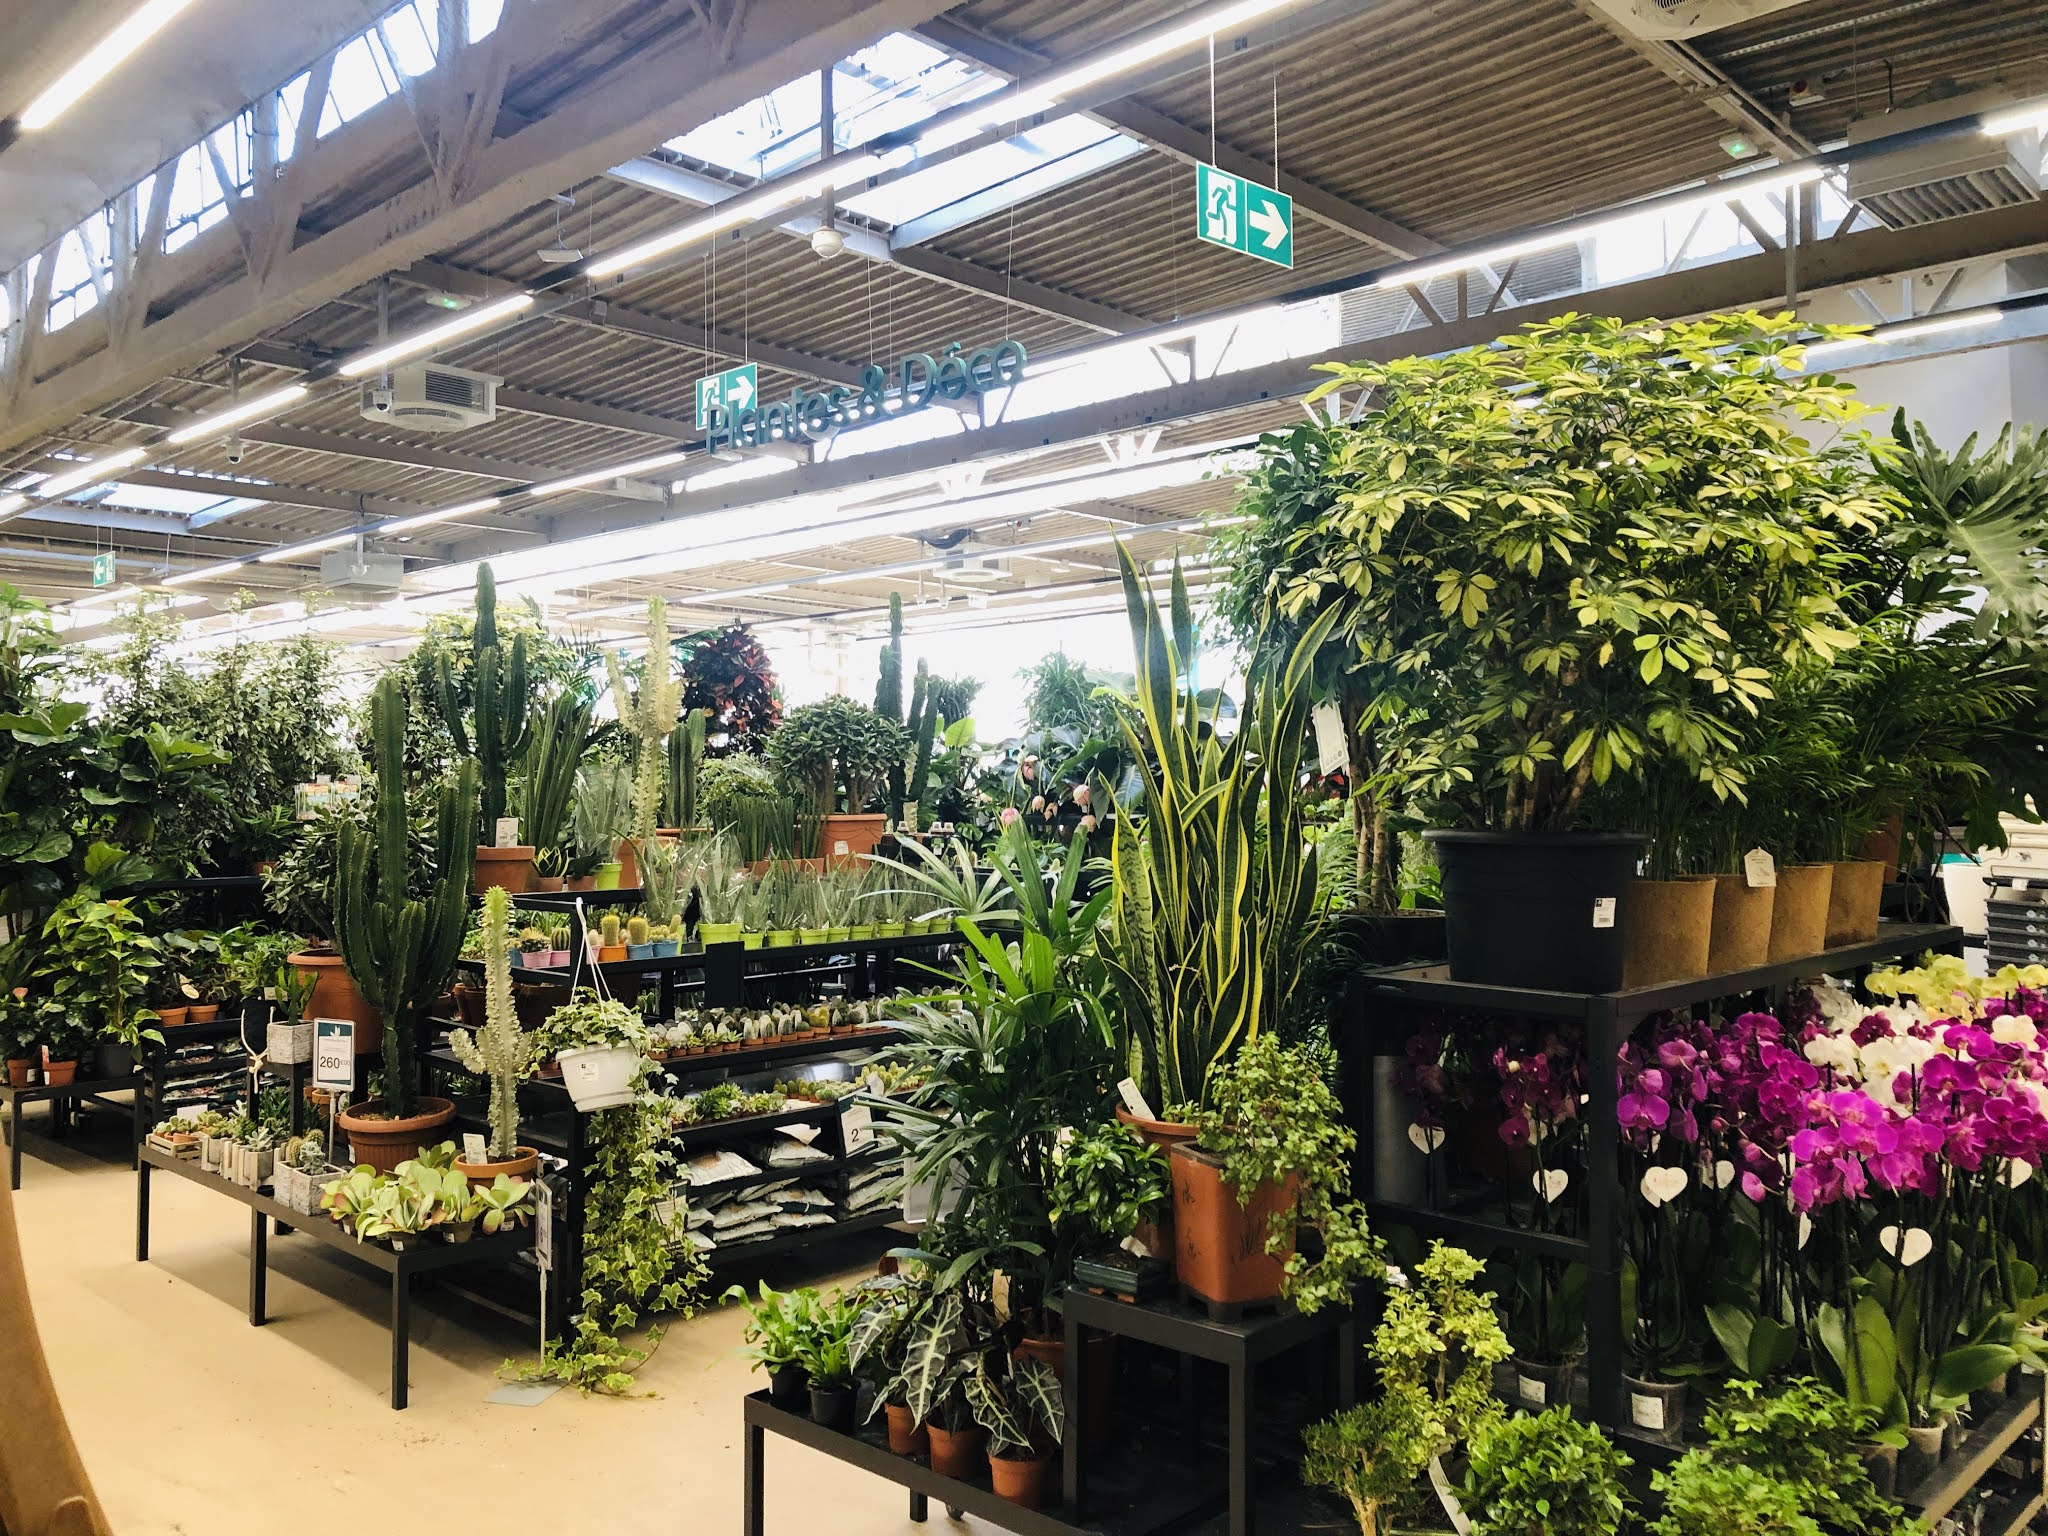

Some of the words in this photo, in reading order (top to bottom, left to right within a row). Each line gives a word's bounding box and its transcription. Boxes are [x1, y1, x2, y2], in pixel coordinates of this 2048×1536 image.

[705, 385, 850, 454] Plantes
[860, 363, 893, 417] &
[900, 339, 1027, 411] Déco
